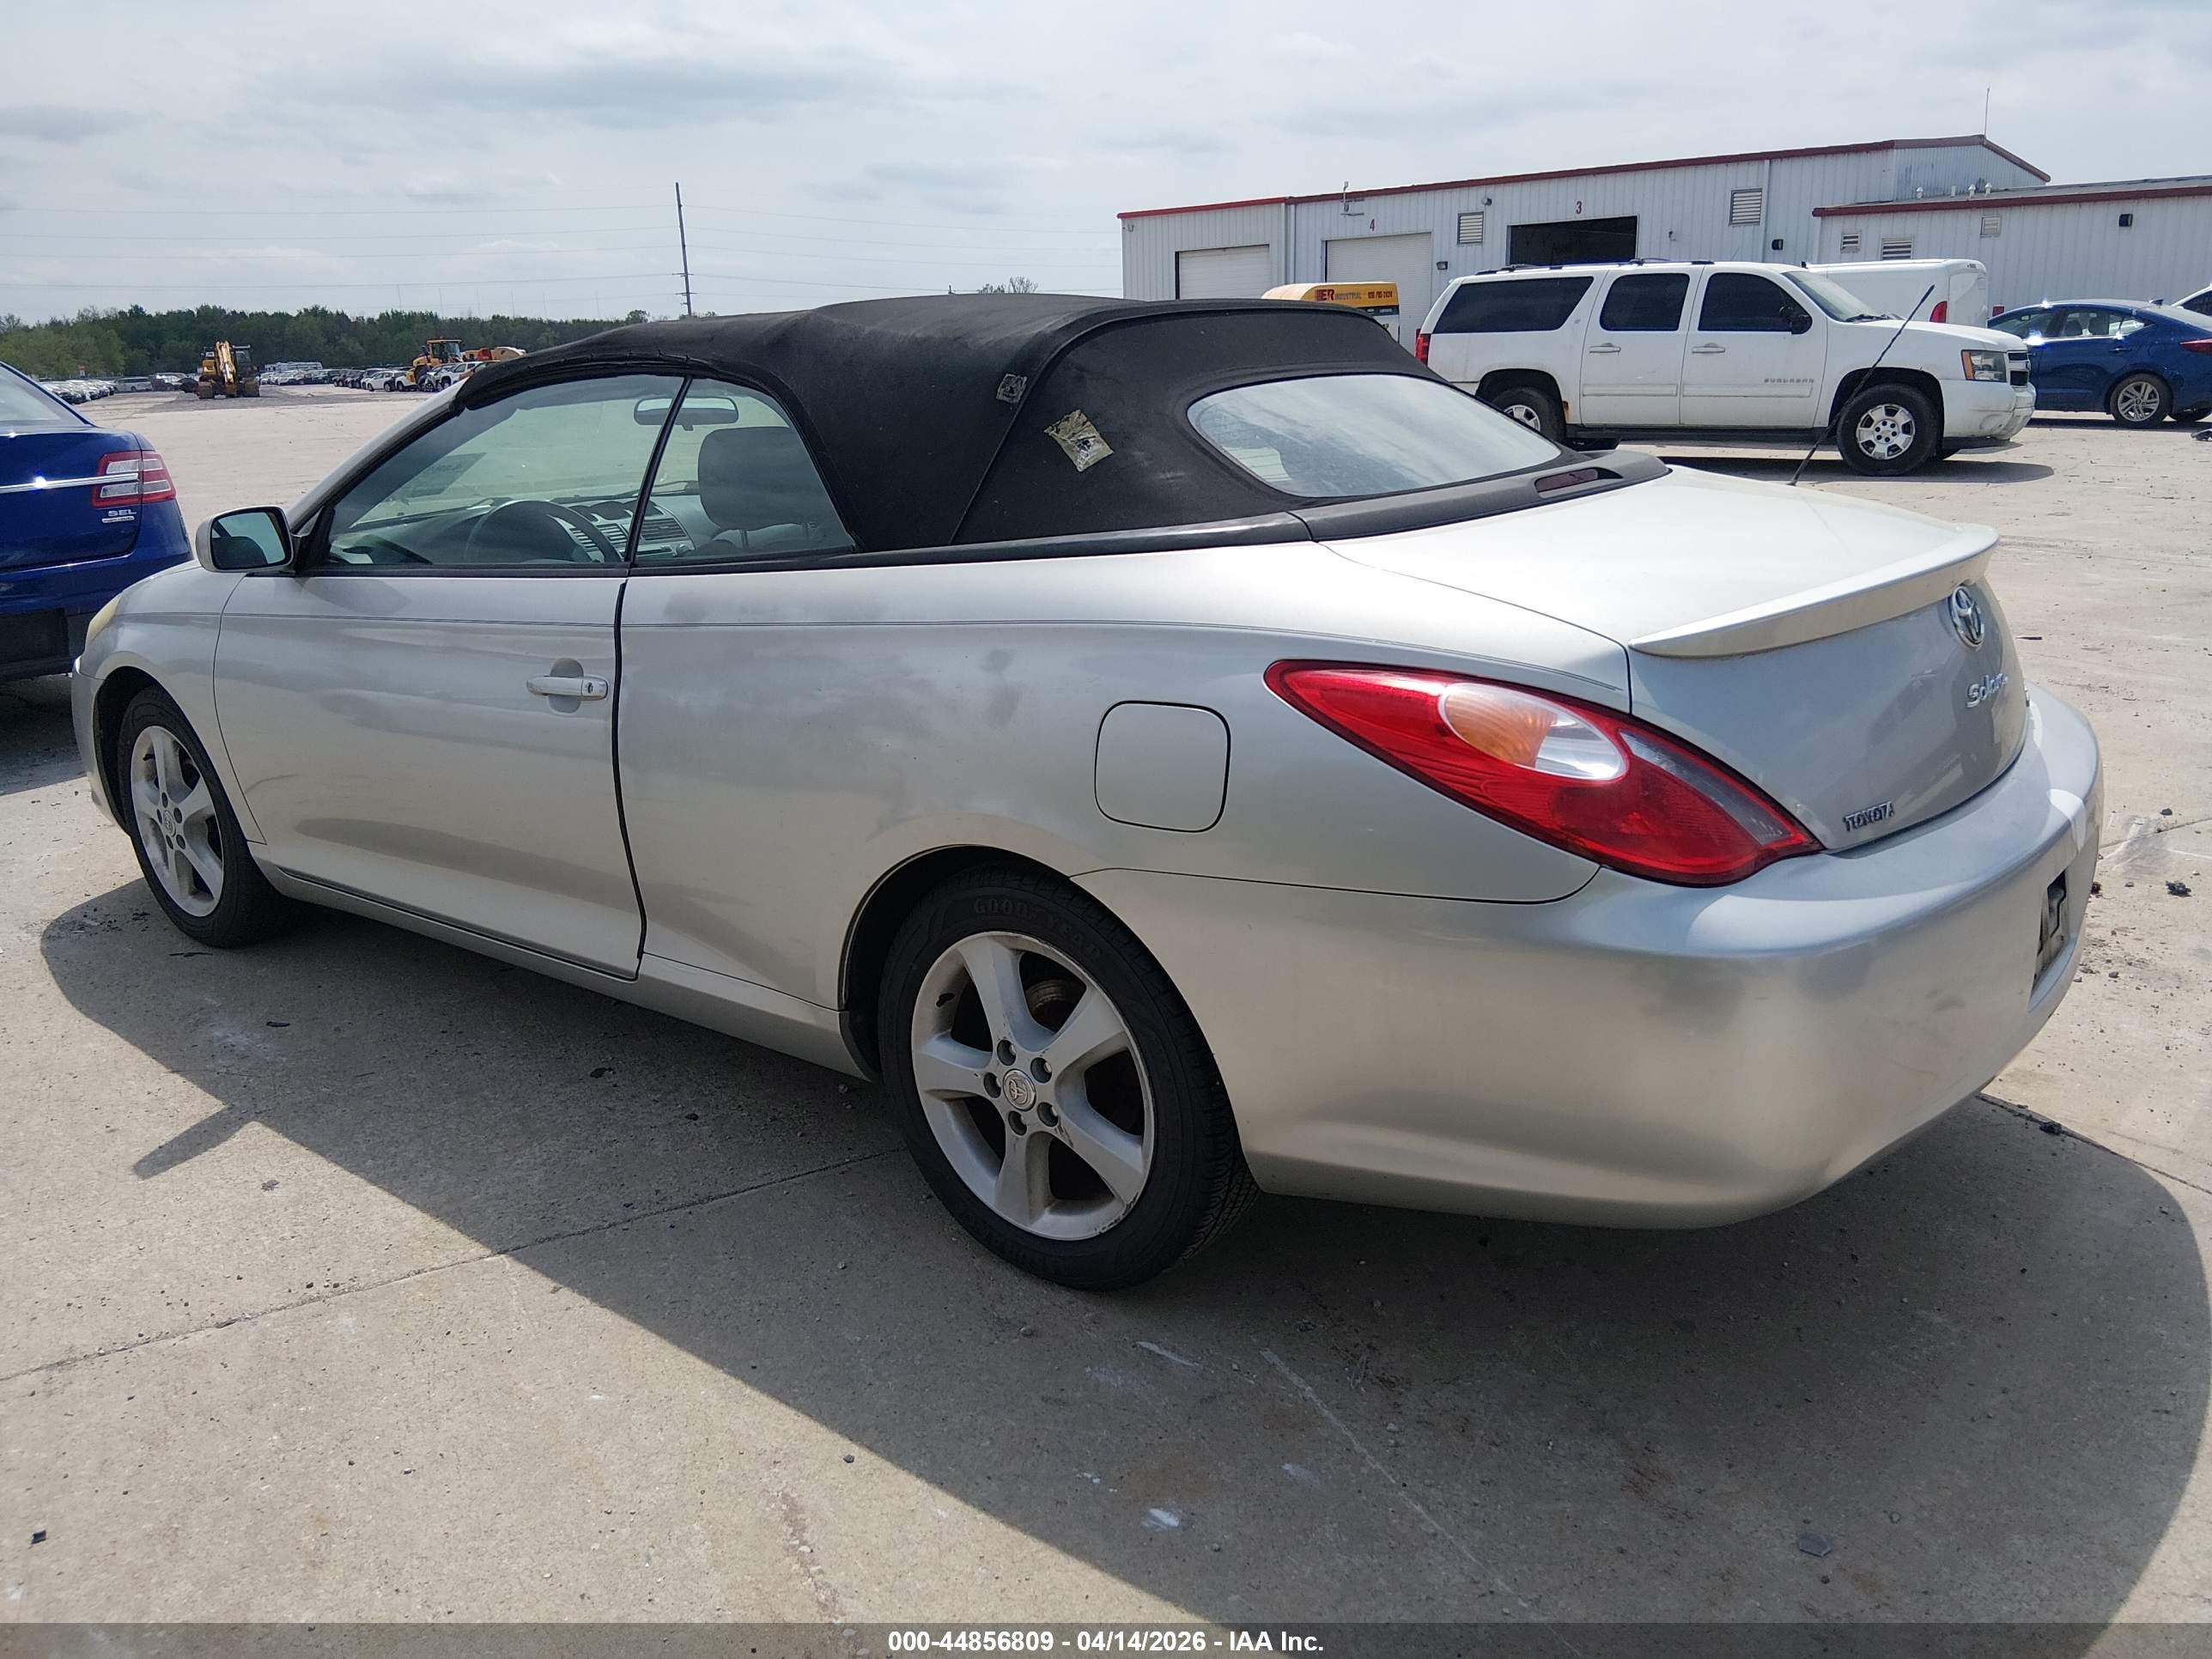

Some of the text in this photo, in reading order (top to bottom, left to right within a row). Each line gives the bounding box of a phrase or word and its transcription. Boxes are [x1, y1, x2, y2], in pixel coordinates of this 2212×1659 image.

[1576, 201, 1582, 215] 3
[1370, 219, 1376, 232] 4
[1842, 801, 1895, 831] TOYOTA
